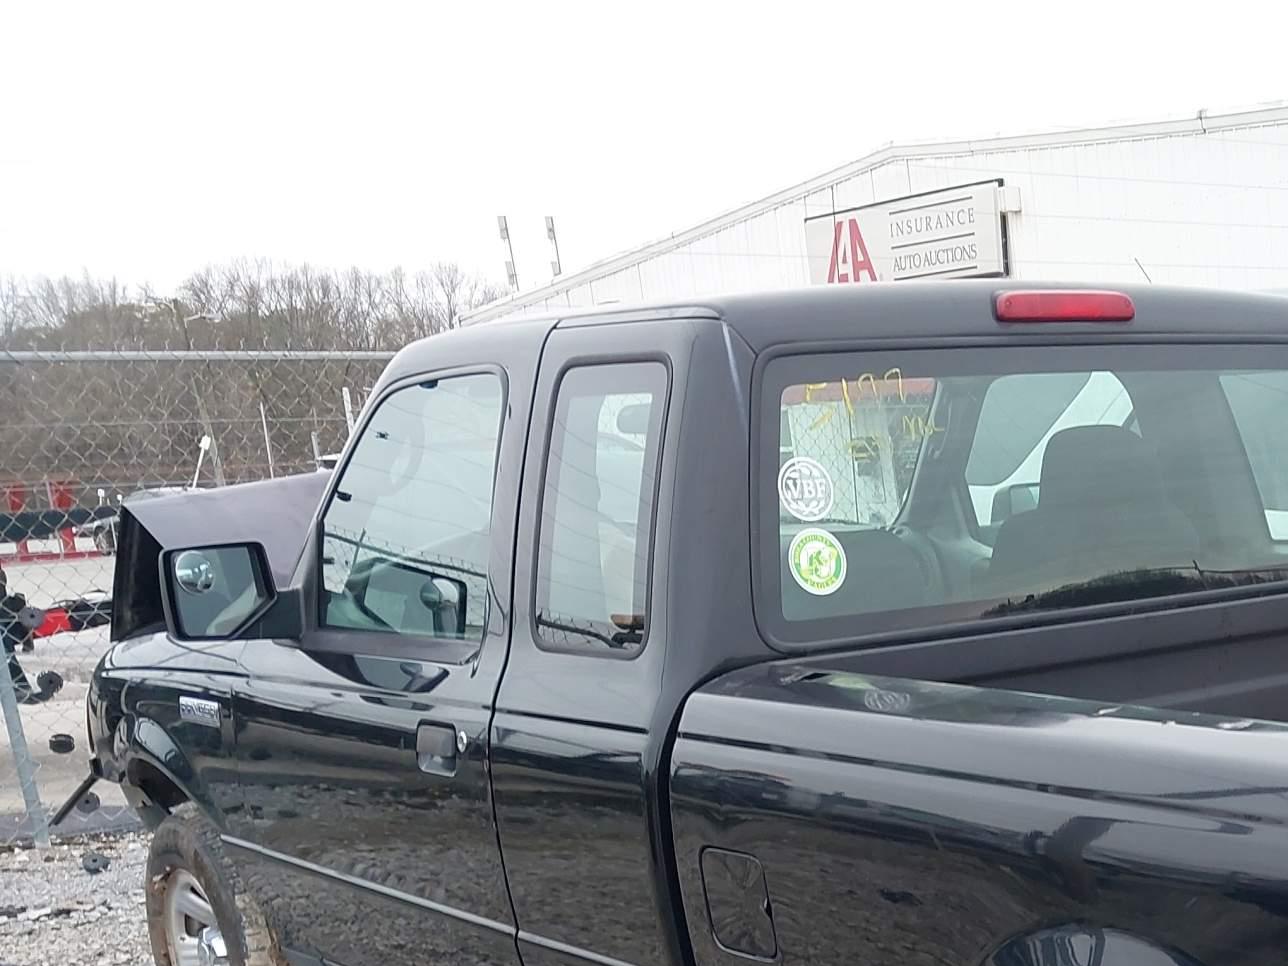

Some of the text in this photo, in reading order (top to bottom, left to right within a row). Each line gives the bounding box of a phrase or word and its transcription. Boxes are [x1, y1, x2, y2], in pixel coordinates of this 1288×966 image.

[890, 208, 975, 238] INSURANCE
[893, 244, 978, 272] AUTO AUCTIONS
